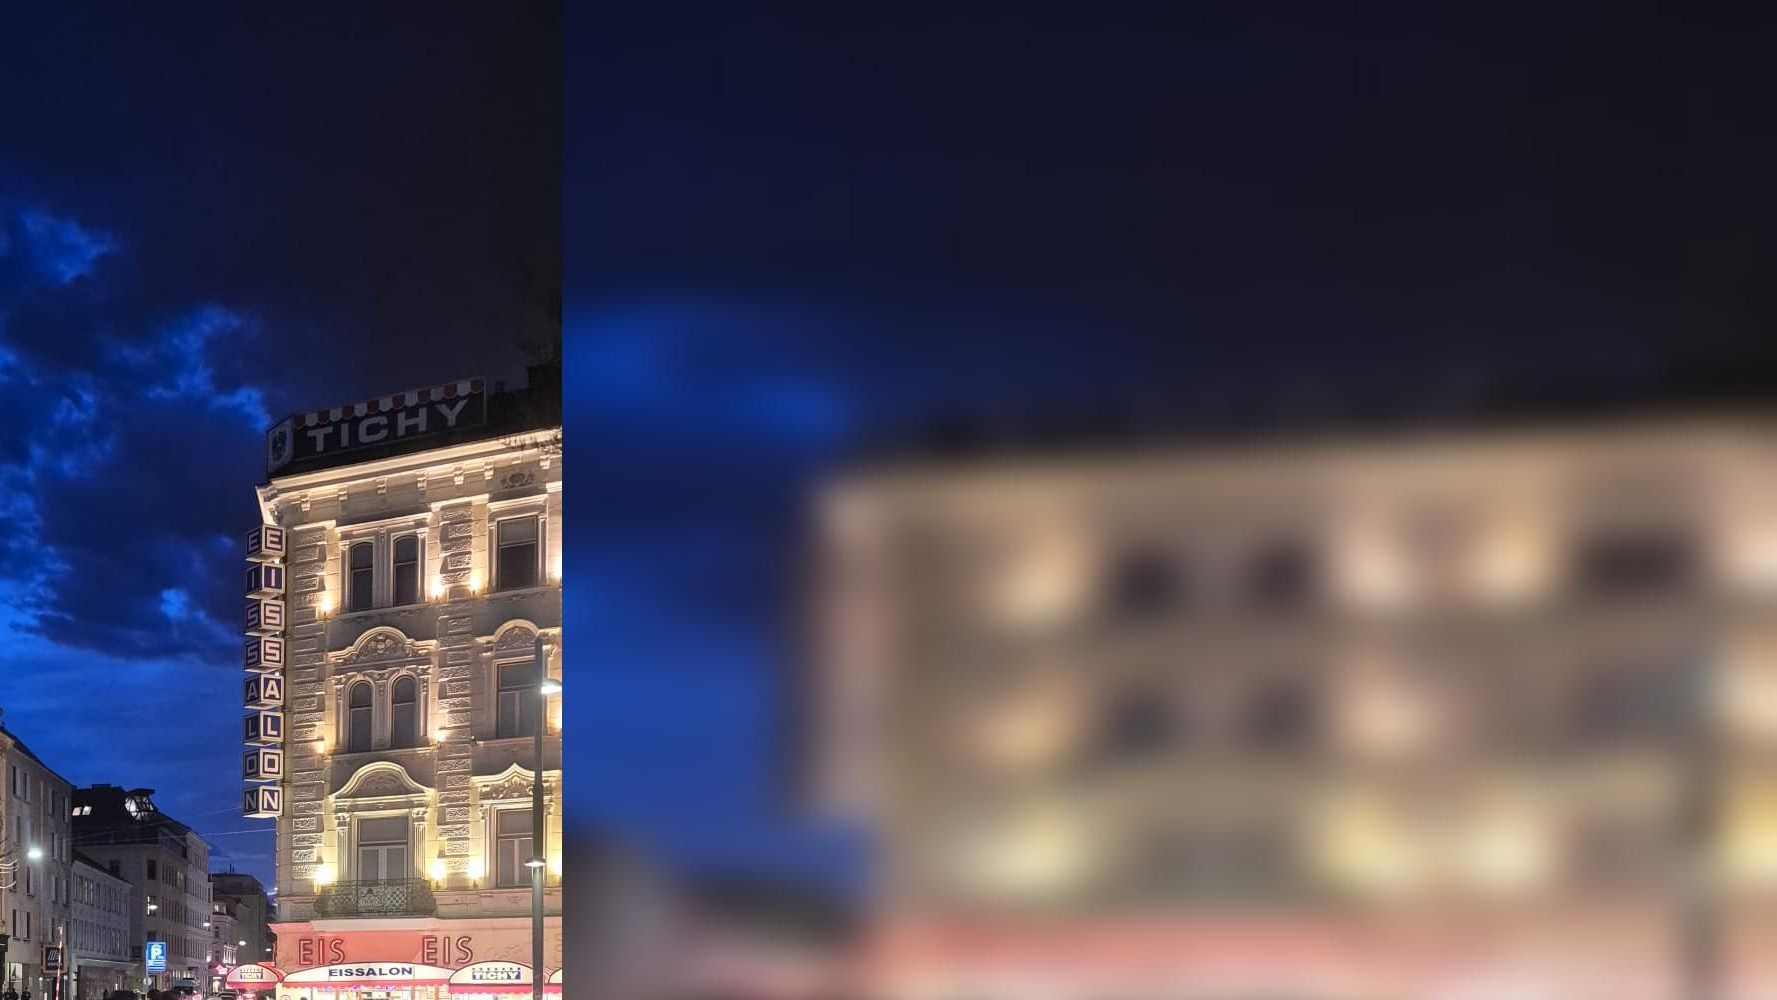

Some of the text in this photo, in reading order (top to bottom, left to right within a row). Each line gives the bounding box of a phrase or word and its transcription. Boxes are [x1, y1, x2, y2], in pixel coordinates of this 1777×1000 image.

[306, 399, 470, 452] TICHY
[244, 530, 261, 811] EISSALON
[261, 528, 283, 810] EISSALON
[298, 938, 346, 966] EIS
[422, 935, 473, 966] EIS
[328, 967, 413, 977] EISSALON
[473, 971, 520, 980] TICHY
